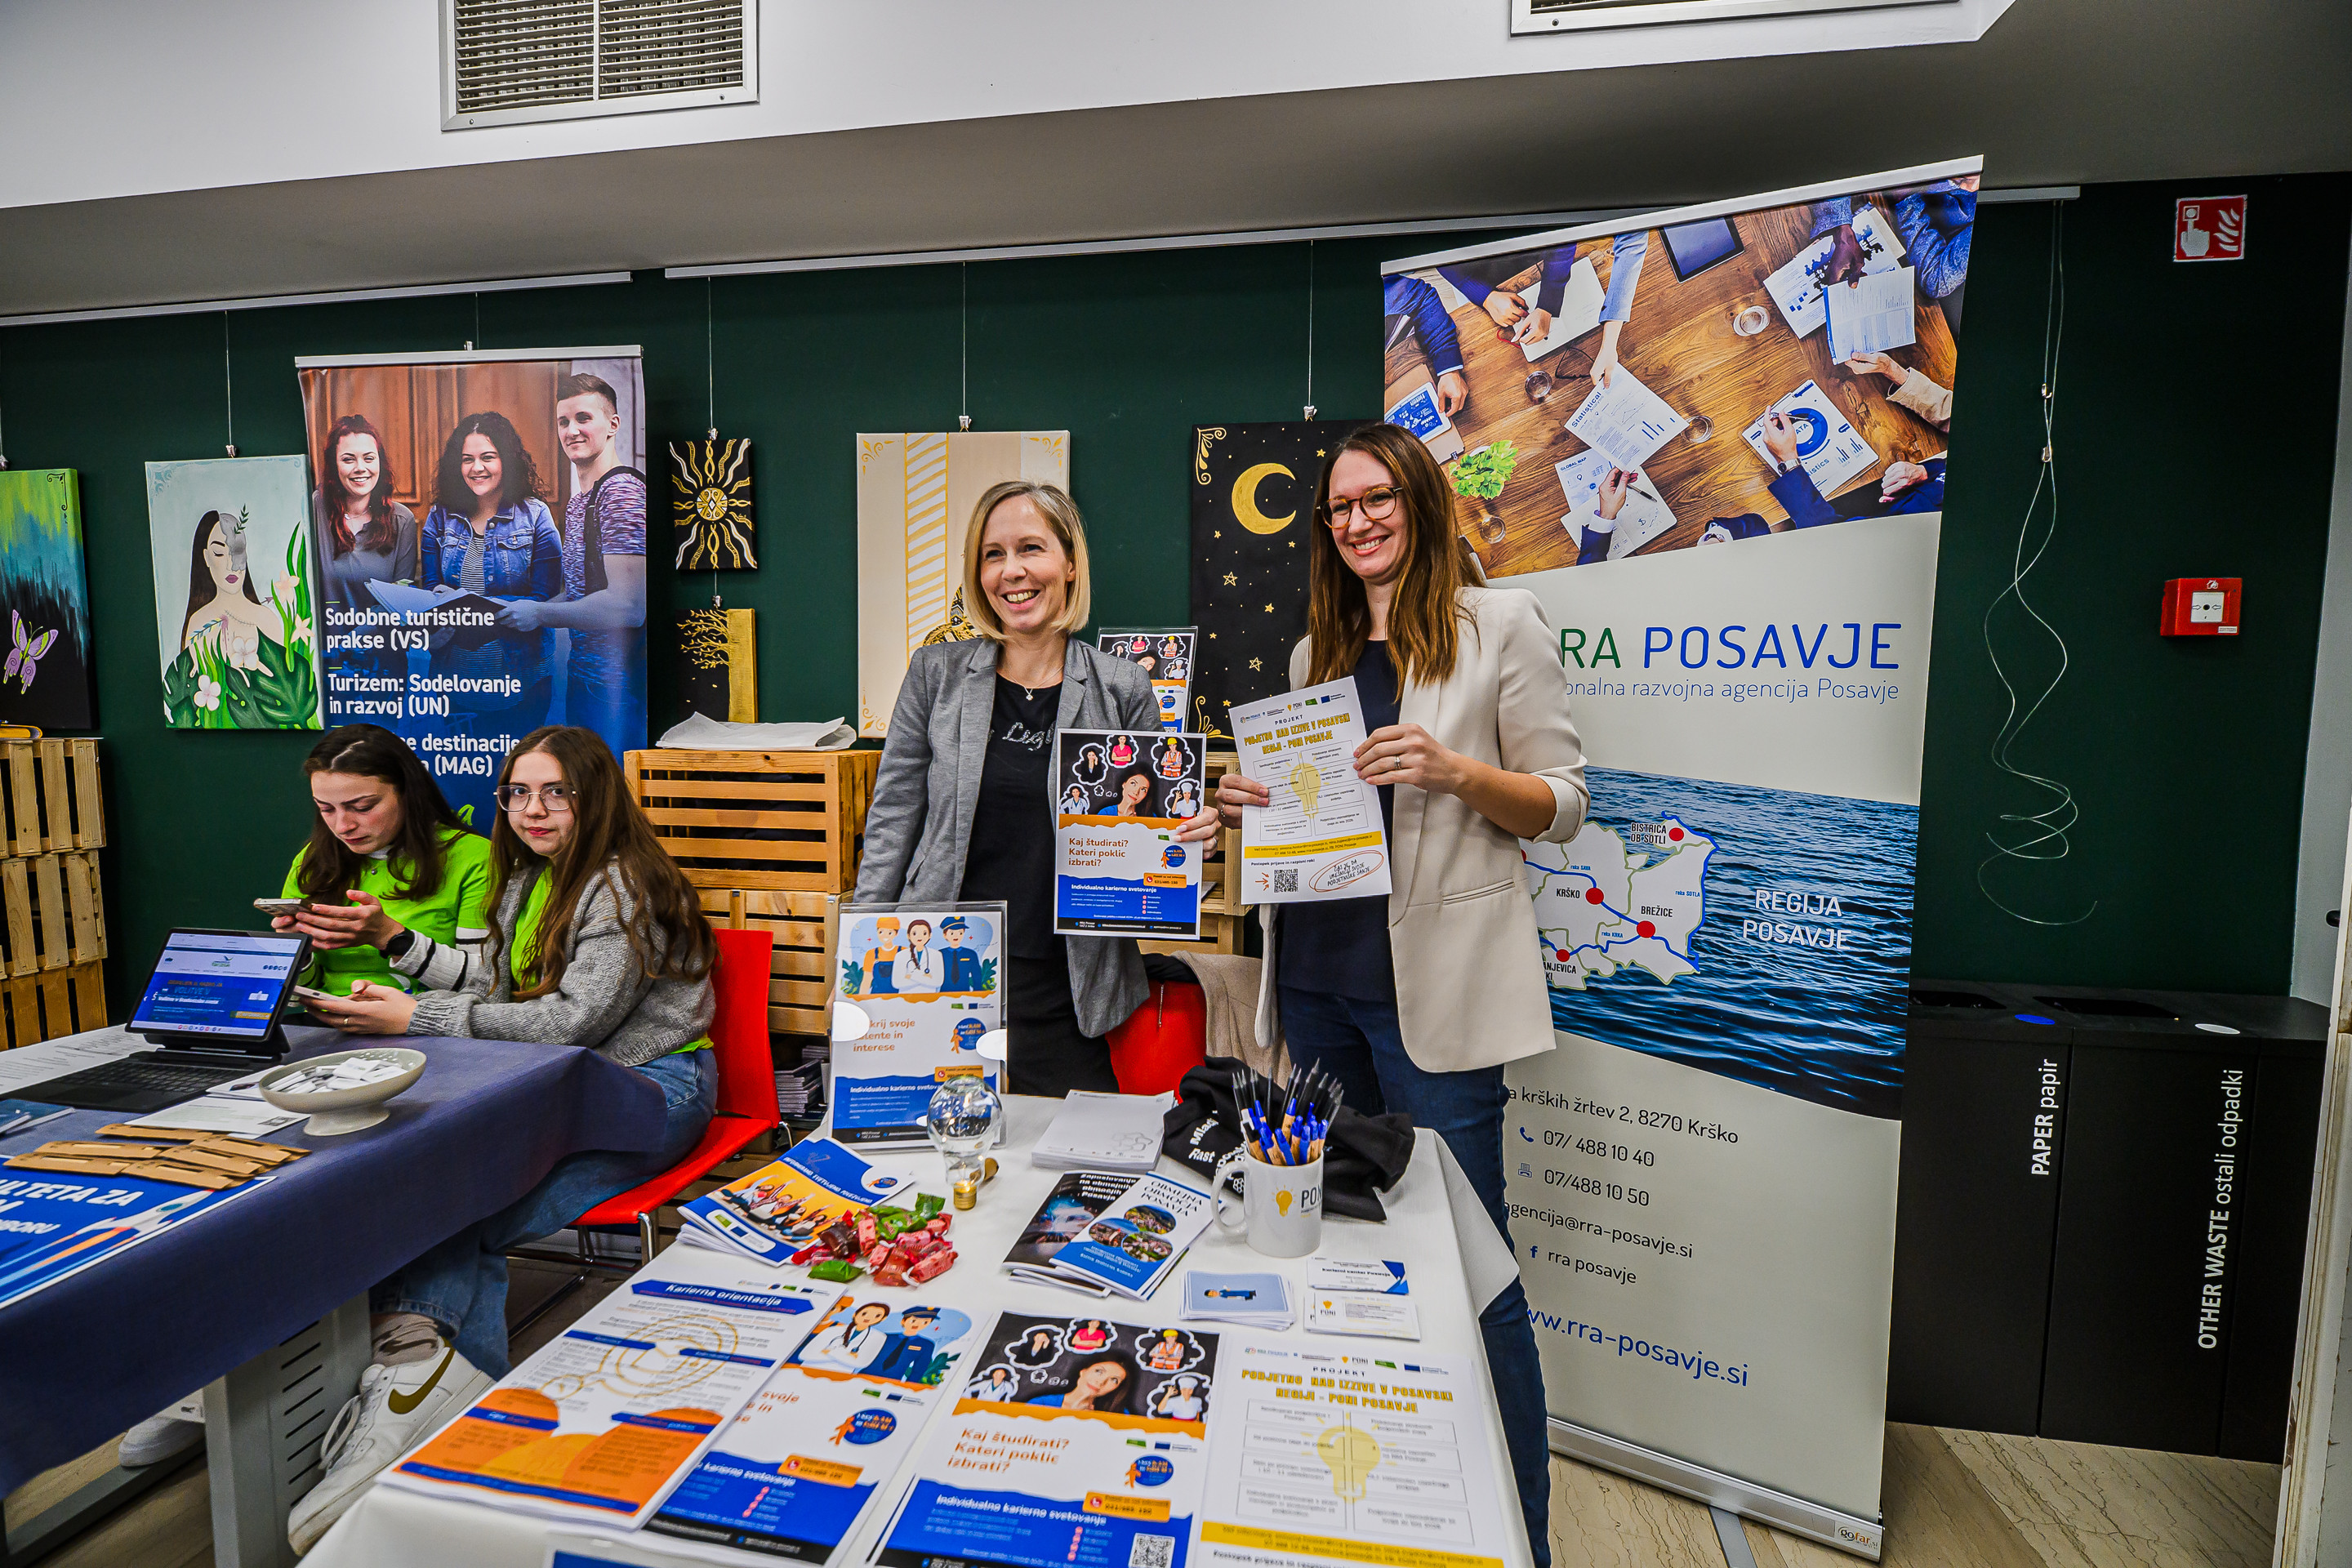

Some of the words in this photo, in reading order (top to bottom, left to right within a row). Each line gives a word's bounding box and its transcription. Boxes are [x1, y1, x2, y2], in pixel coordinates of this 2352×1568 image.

[1571, 391, 1602, 428] Statistical
[1560, 461, 1578, 471] GLOBAL
[325, 608, 401, 626] Sodobne
[406, 606, 495, 627] turistične
[327, 630, 385, 654] prakse
[390, 628, 430, 652] (VS)
[1644, 622, 1902, 670] POSAVJE
[328, 675, 403, 693] Turizem:
[409, 675, 521, 697] Sodelovanje
[1633, 680, 1713, 702] razvojna
[1722, 679, 1808, 703] agencija
[1818, 678, 1899, 704] Posavje
[330, 696, 341, 714] in
[346, 697, 403, 718] razvoj
[408, 694, 450, 717] (UN)
[1275, 715, 1303, 725] PROJEKT
[1290, 723, 1310, 735] IZZIVE
[1311, 721, 1316, 729] V
[1317, 713, 1351, 728] POSAVSKI
[1288, 738, 1303, 749] PONI
[1305, 730, 1333, 745] POSAVJE
[435, 754, 492, 777] (MAG)
[1630, 833, 1641, 844] OB
[1642, 834, 1667, 844] SOTLI
[1631, 822, 1667, 835] BISTRICA
[1069, 838, 1085, 849] Kaj
[1085, 838, 1129, 849] študirati?
[1069, 848, 1096, 858] Kateri
[1098, 849, 1126, 858] poklic
[1068, 858, 1102, 867] izbrati?
[1356, 866, 1370, 876] SANJE
[1556, 887, 1580, 899] KRŠKO
[1755, 889, 1842, 917] REGIJA
[1641, 905, 1673, 917] BREŽICE
[1743, 920, 1852, 950] POSAVJE
[889, 1018, 915, 1029] svoje
[894, 1031, 903, 1039] in
[853, 1044, 895, 1052] interese
[2038, 1059, 2061, 1109] papir
[1521, 1086, 1569, 1111] krških
[1574, 1097, 1615, 1120] žrtev
[1619, 1106, 1633, 1124] 2,
[1637, 1109, 1682, 1132] 8270
[1688, 1118, 1739, 1144] Krško
[2217, 1069, 2243, 1147] odpadki
[1188, 1148, 1215, 1163] Rast
[1544, 1129, 1572, 1149] 07/
[1575, 1137, 1606, 1157] 488
[1611, 1144, 1628, 1161] 10
[1633, 1150, 1655, 1167] 40
[2031, 1114, 2055, 1175] PAPER
[1544, 1169, 1601, 1196] 07/488
[1606, 1183, 1623, 1200] 10
[1627, 1188, 1650, 1206] 50
[2214, 1153, 2235, 1205] ostali
[87, 1189, 145, 1206] ZA
[2204, 1210, 2229, 1278] WASTE
[1548, 1250, 1570, 1267] rra
[1575, 1258, 1637, 1285] posavje
[666, 1284, 716, 1297] Karierna
[717, 1291, 782, 1307] orientacija
[2198, 1284, 2222, 1349] OTHER
[1312, 1366, 1366, 1377] PROJEKT
[1352, 1356, 1369, 1365] PONI
[1241, 1369, 1303, 1385] PODJETNO
[1311, 1376, 1335, 1388] NAD
[1339, 1379, 1376, 1394] IZZIVE
[1379, 1383, 1388, 1394] V
[1392, 1386, 1454, 1402] POSAVSKI
[759, 1402, 773, 1413] in
[1276, 1388, 1315, 1401] REGIJI
[1329, 1393, 1358, 1406] PONI
[1362, 1396, 1419, 1414] POSAVJE
[961, 1428, 987, 1443] Kaj
[991, 1432, 1070, 1450] študirati?
[955, 1441, 1005, 1459] Kateri
[1008, 1447, 1060, 1465] poklic
[947, 1457, 1011, 1474] izbrati?
[936, 1494, 1001, 1514] Individualno
[1003, 1502, 1047, 1519] karierno
[1049, 1508, 1107, 1526] svetovanje
